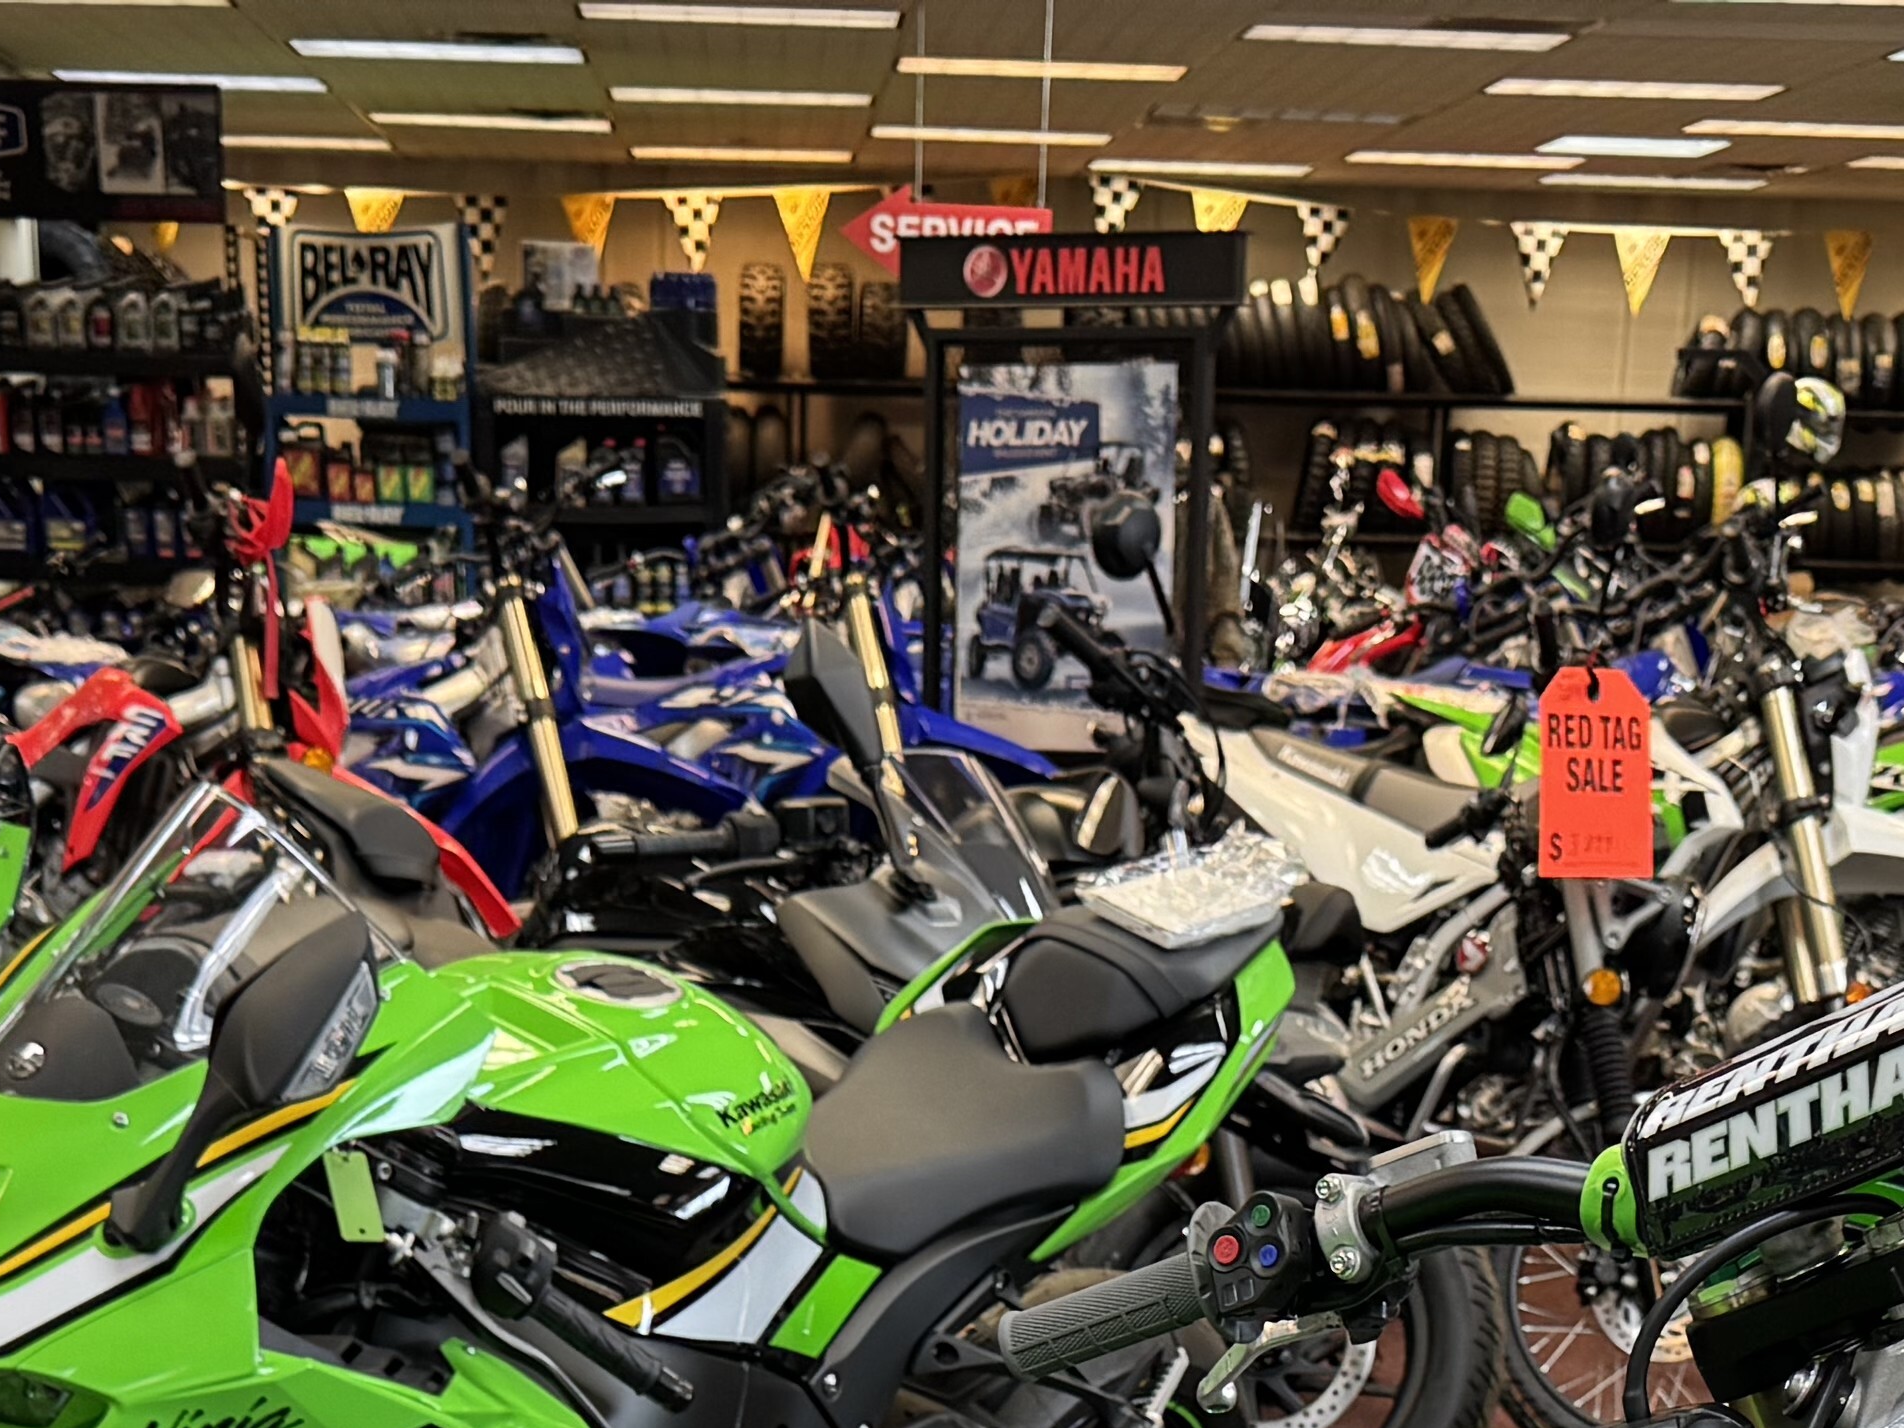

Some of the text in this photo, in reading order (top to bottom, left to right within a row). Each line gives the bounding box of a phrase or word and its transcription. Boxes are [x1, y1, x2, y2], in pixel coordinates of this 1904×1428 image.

[1010, 245, 1165, 295] YAMAHA
[966, 417, 1090, 448] HOLIDAY
[1547, 713, 1642, 751] RED TAG
[1565, 756, 1625, 794] SALE
[1359, 989, 1475, 1080] HONDA
